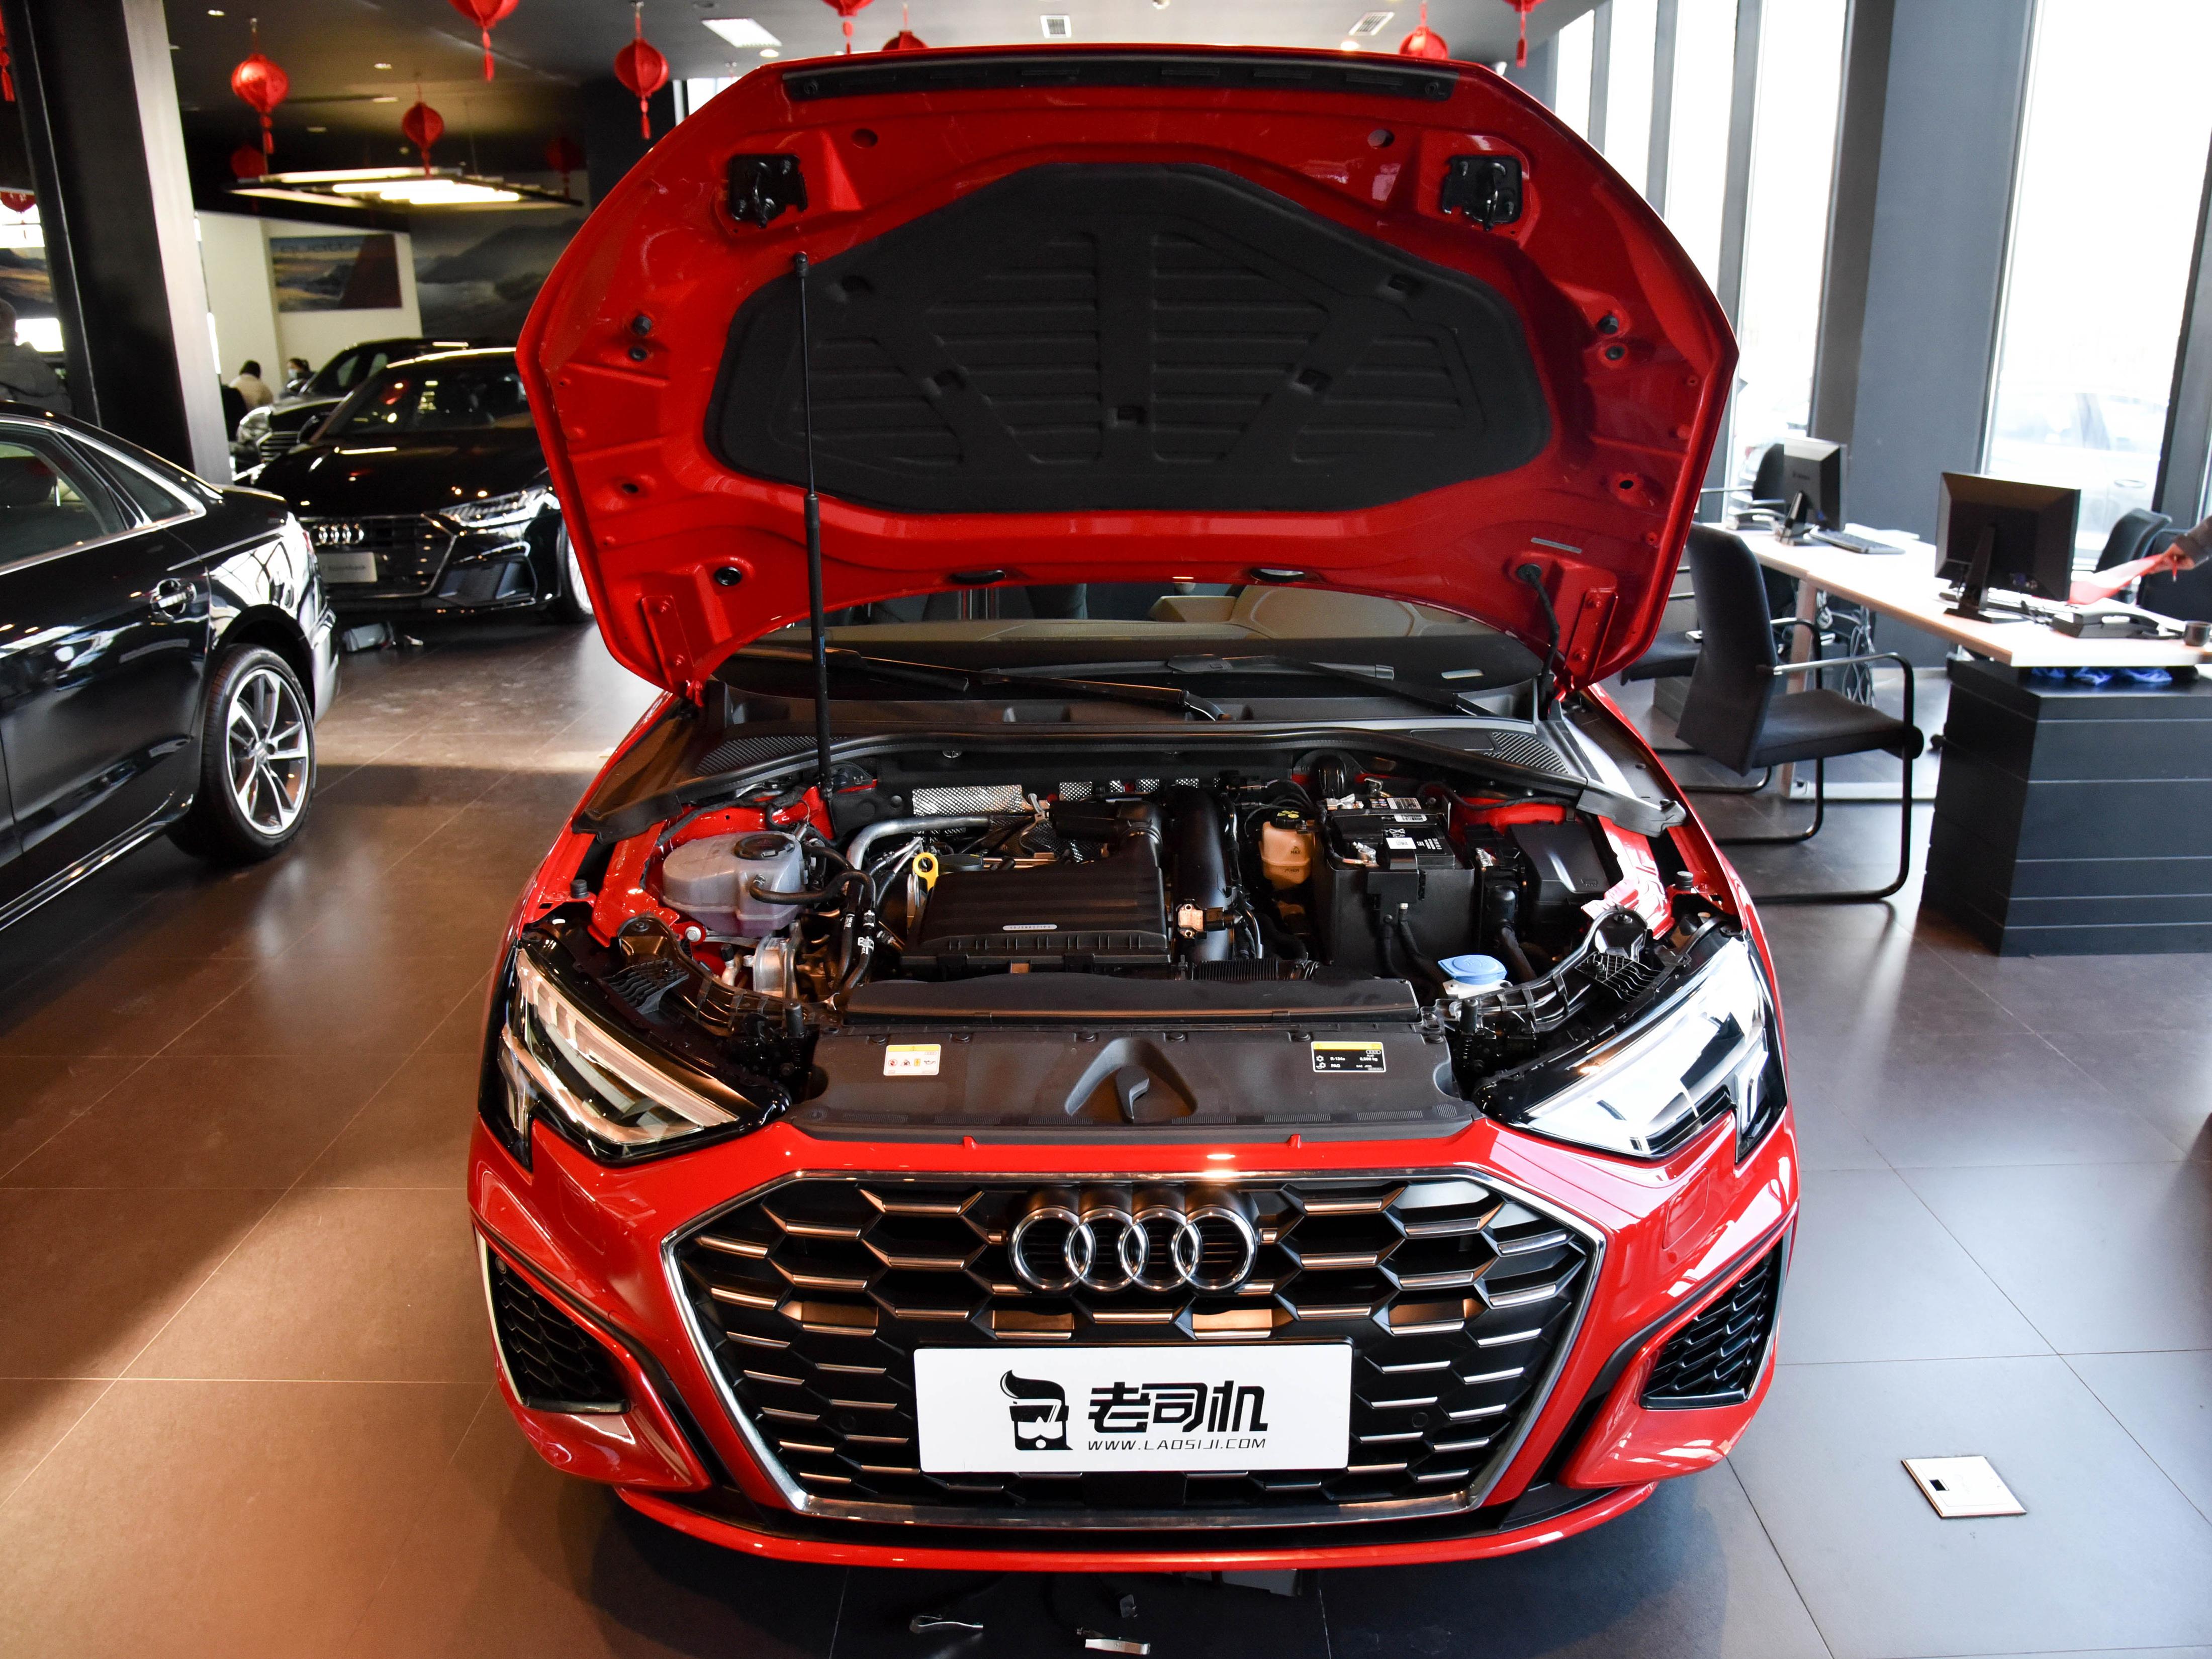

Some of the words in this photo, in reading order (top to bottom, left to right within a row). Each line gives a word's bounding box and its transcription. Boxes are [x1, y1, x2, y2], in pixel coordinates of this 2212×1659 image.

[1088, 1380, 1268, 1433] 老司机
[1088, 1438, 1266, 1450] WWW.LAOSIJI.COM
